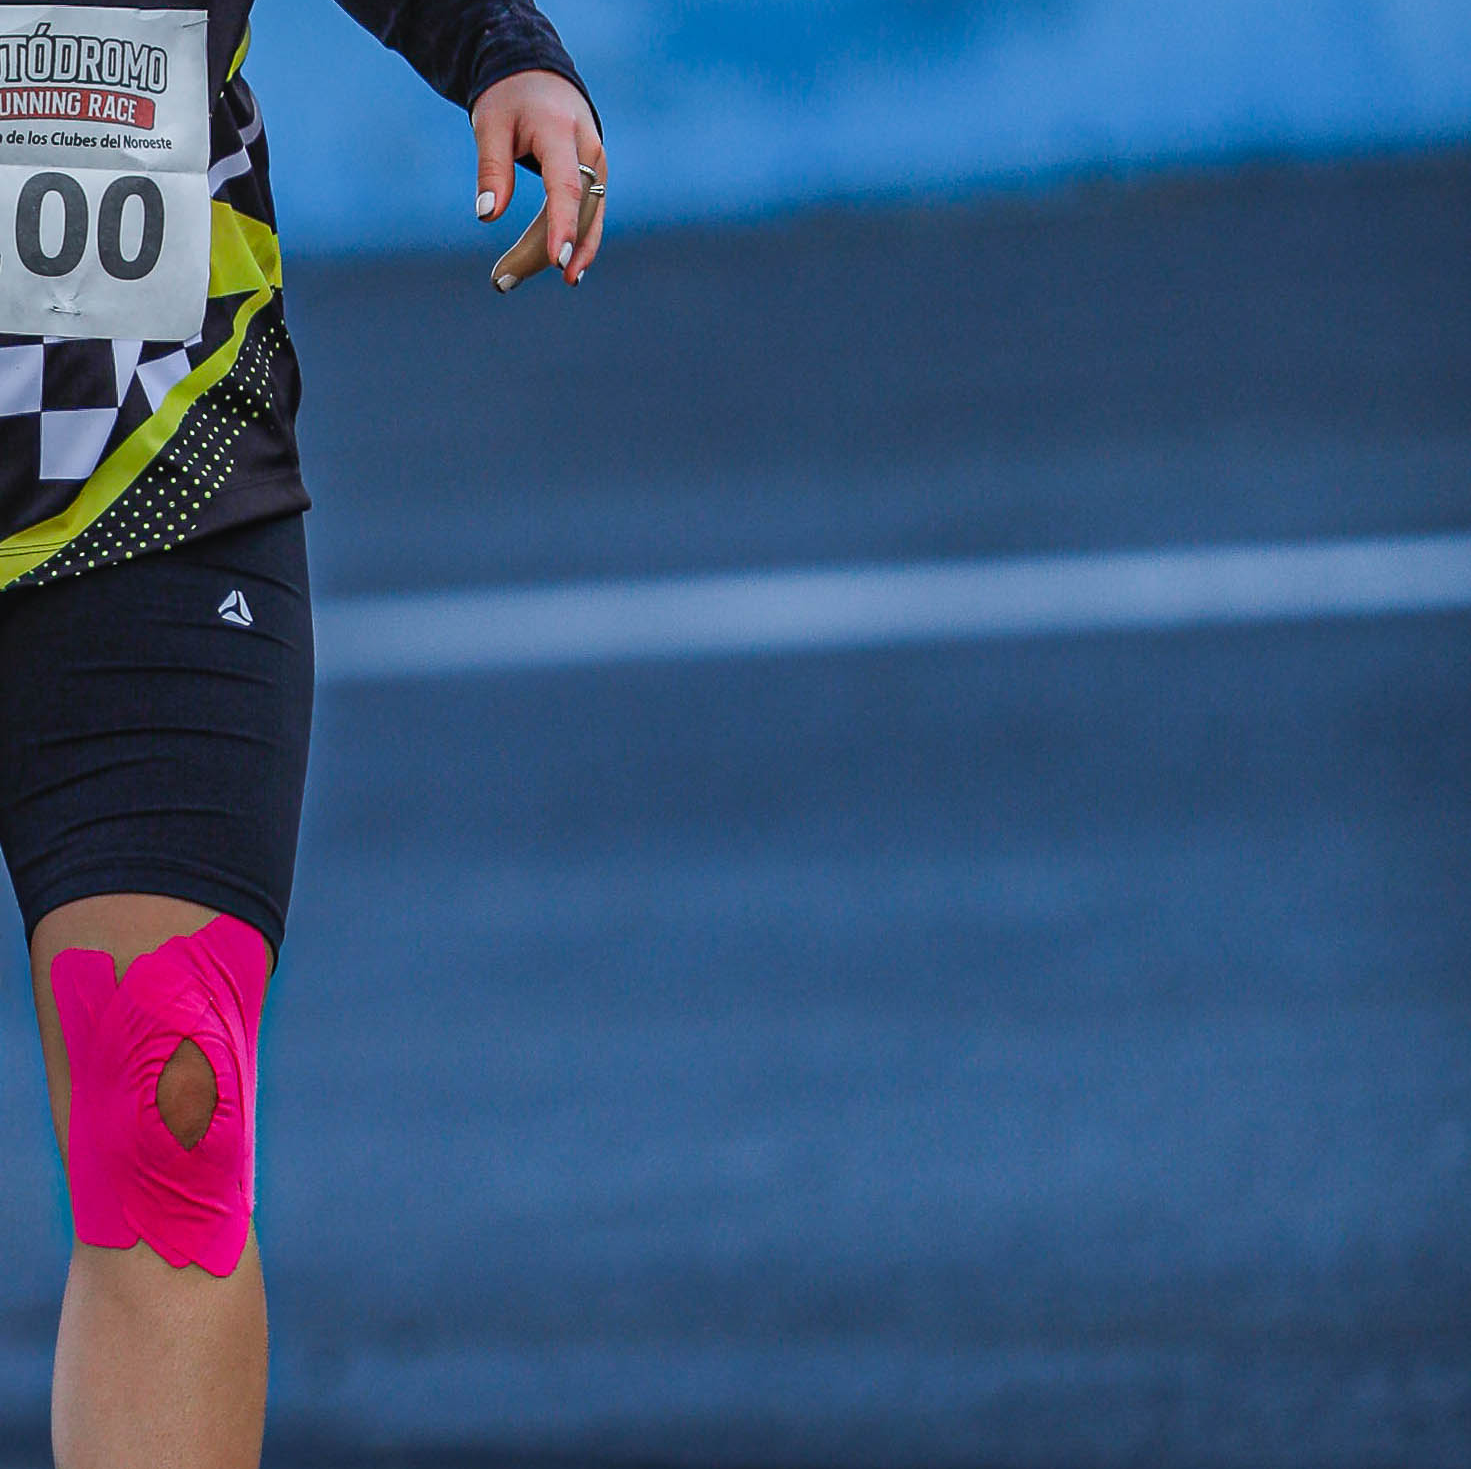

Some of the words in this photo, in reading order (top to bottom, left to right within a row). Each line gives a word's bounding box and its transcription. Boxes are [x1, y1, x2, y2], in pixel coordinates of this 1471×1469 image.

[89, 93, 137, 124] RACE
[6, 131, 25, 145] de
[28, 131, 48, 146] los
[50, 132, 97, 148] Clubes
[100, 134, 121, 149] del
[123, 136, 172, 150] Noroeste
